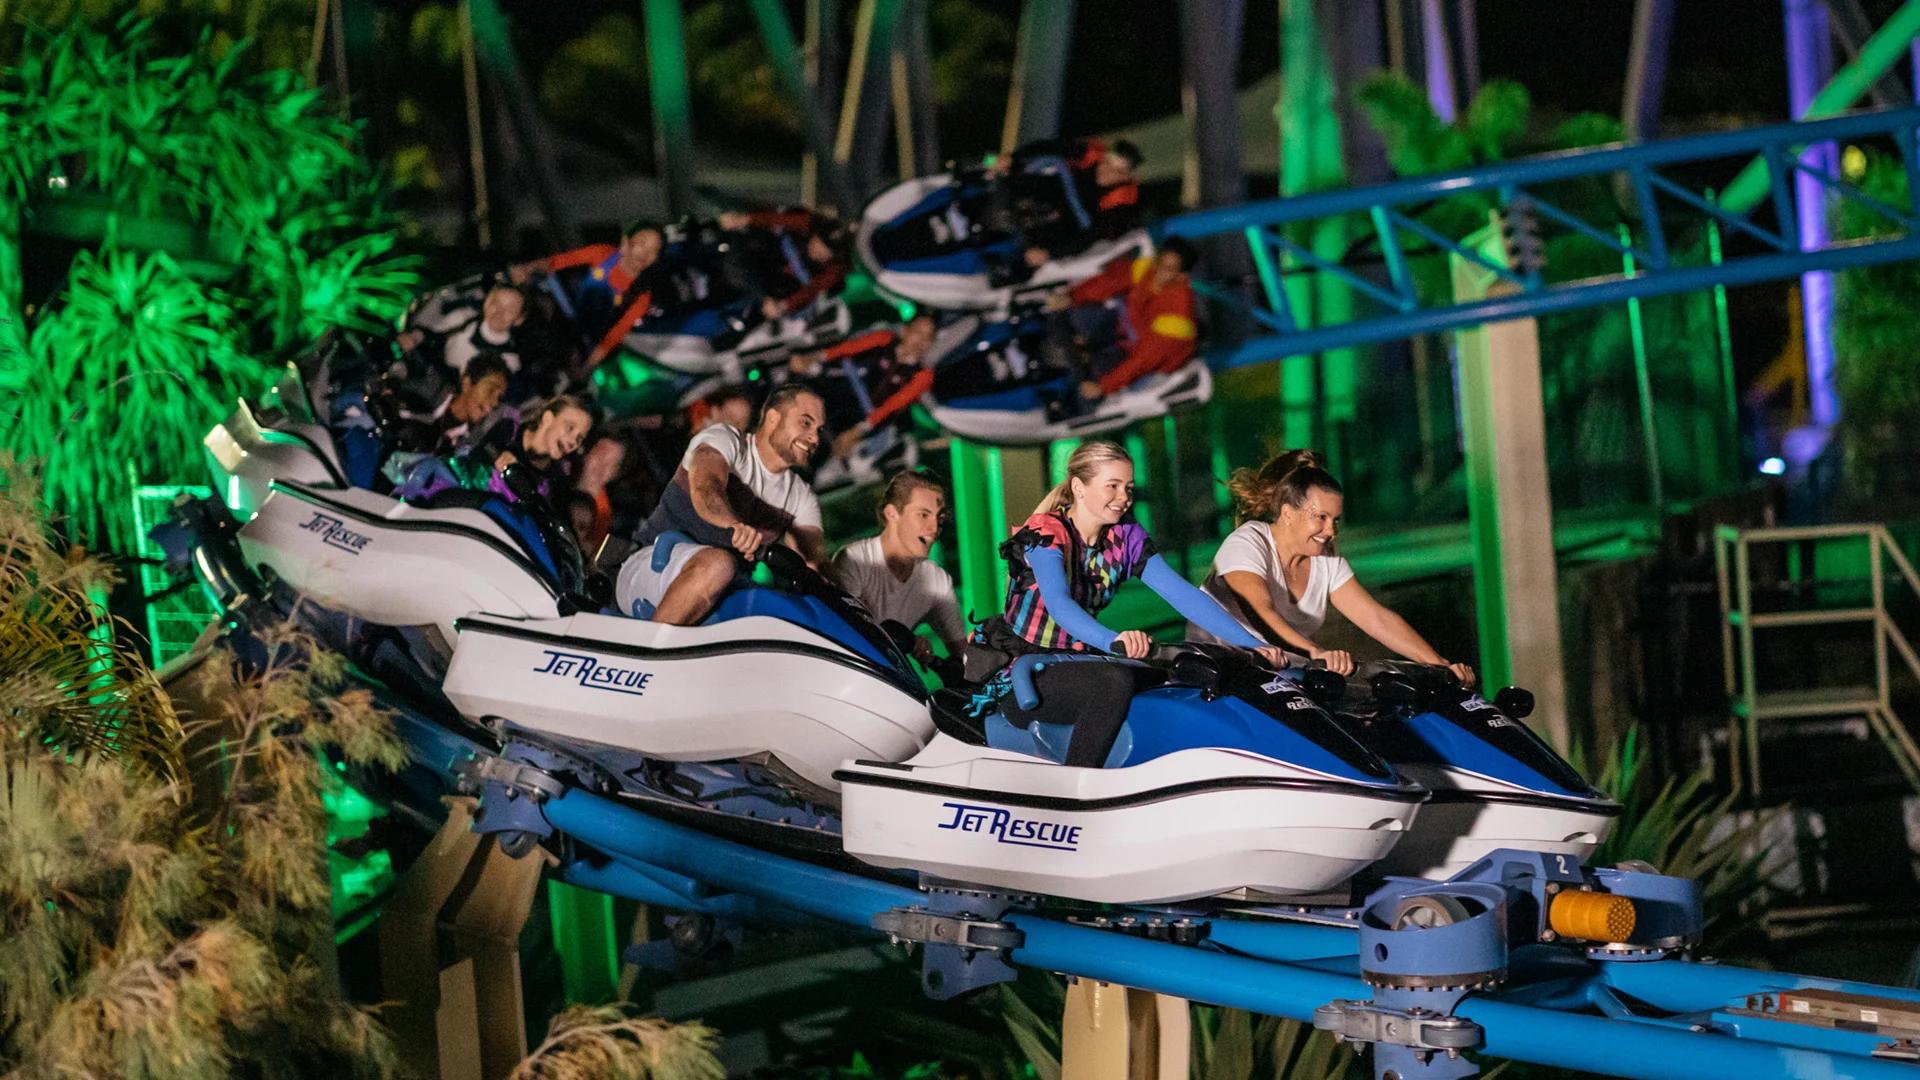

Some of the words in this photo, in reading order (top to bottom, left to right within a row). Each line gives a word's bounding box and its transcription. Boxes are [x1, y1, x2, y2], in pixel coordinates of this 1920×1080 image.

[533, 650, 578, 676] JET
[575, 657, 654, 695] RESCUE
[938, 802, 988, 832] JET
[989, 809, 1082, 851] RESCUE
[1556, 855, 1569, 875] 2
